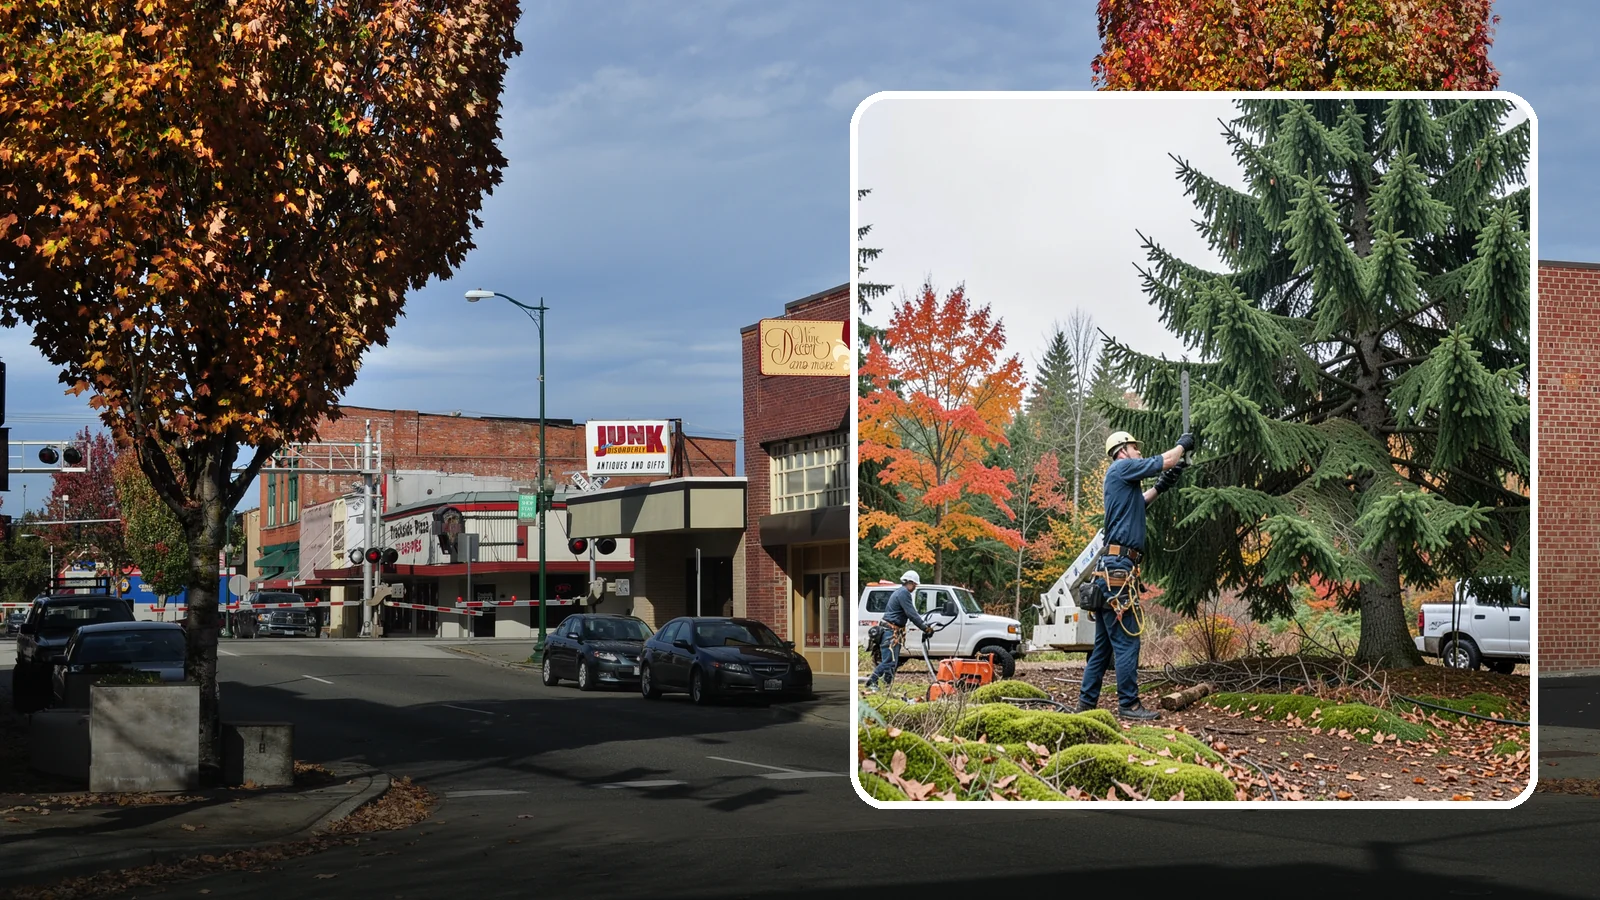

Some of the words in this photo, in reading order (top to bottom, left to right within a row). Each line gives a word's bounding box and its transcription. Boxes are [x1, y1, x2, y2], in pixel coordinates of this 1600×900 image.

[595, 425, 665, 457] JUNK
[607, 446, 645, 454] DISORDERLY
[597, 461, 628, 470] ANTIQUES
[631, 461, 644, 470] AND
[647, 460, 665, 469] GIFTS
[414, 519, 429, 535] Pizza
